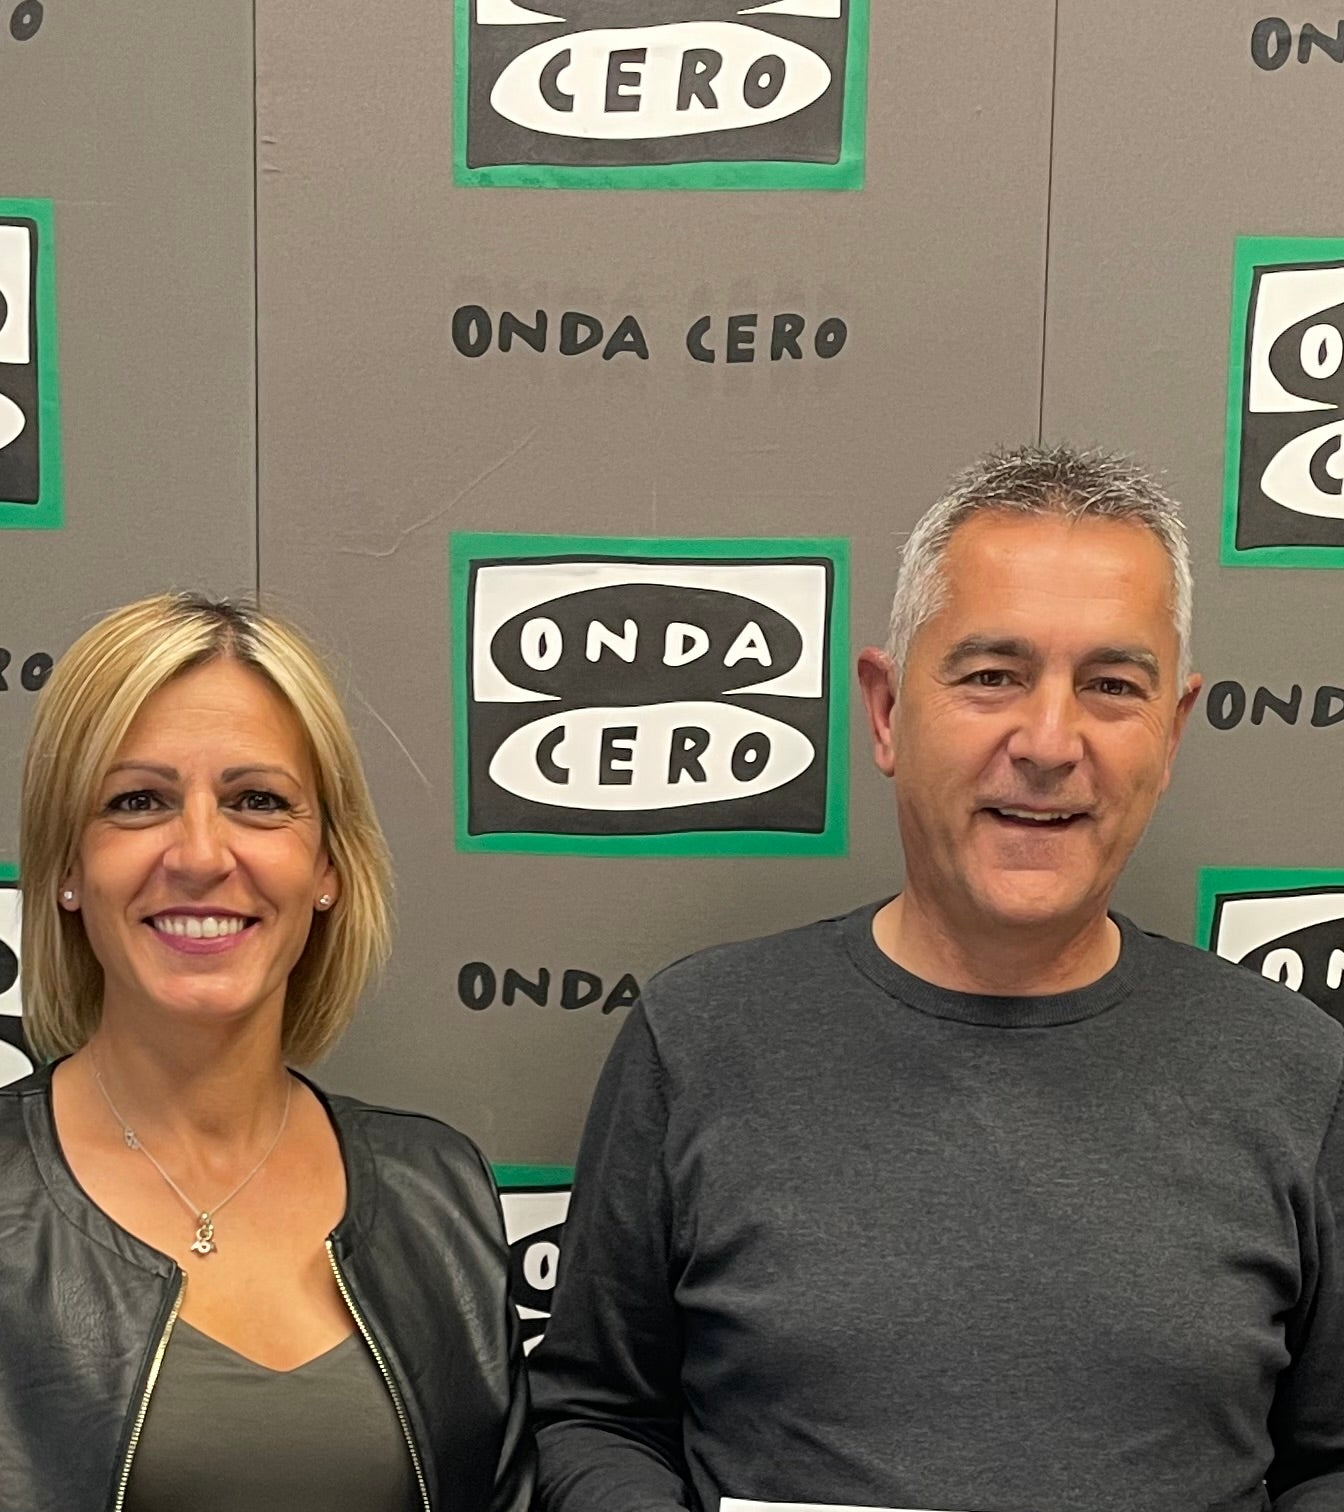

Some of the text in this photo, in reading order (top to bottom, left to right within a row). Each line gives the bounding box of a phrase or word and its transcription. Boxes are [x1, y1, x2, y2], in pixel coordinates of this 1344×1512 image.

[539, 48, 786, 113] CERO
[451, 305, 848, 364] ONDA CERO
[520, 617, 773, 670] ONDA
[536, 726, 771, 786] CERO
[458, 961, 641, 1015] ONDA
